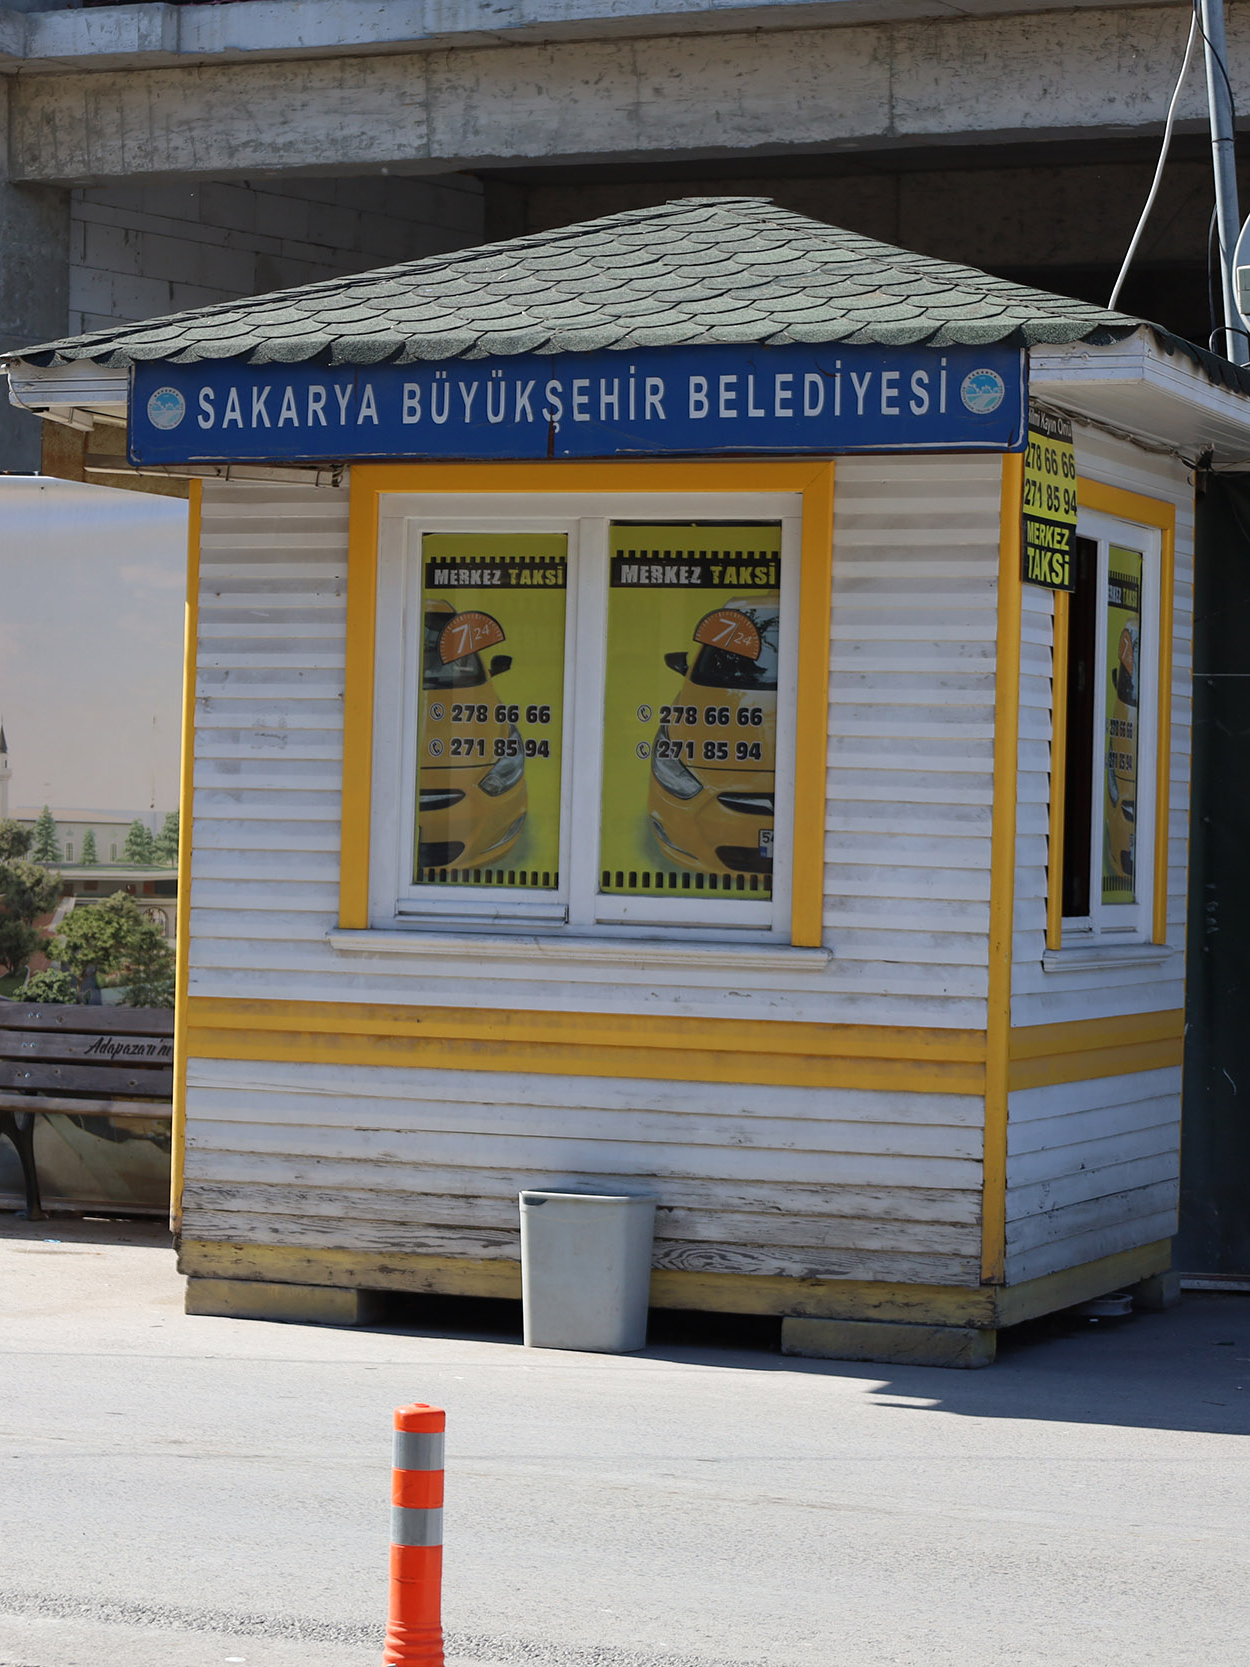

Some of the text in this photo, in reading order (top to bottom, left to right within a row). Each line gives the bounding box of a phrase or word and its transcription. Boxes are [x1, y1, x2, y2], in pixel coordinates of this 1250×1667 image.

[197, 383, 379, 430] SAKARYA
[402, 366, 666, 434] BÜYÜKŞEHİR
[688, 357, 948, 420] BELEDİYESİ
[1025, 441, 1076, 480] 278 66 66
[1024, 478, 1077, 516] 271 85 94
[1026, 520, 1070, 551] MERKEZ
[433, 568, 502, 586] MERKEZ
[620, 564, 702, 584] MERKEZ
[451, 704, 551, 724] 278 66 66
[659, 706, 763, 726] 278 66 66
[450, 738, 550, 759] 271 85 94
[658, 740, 762, 761] 271 85 94
